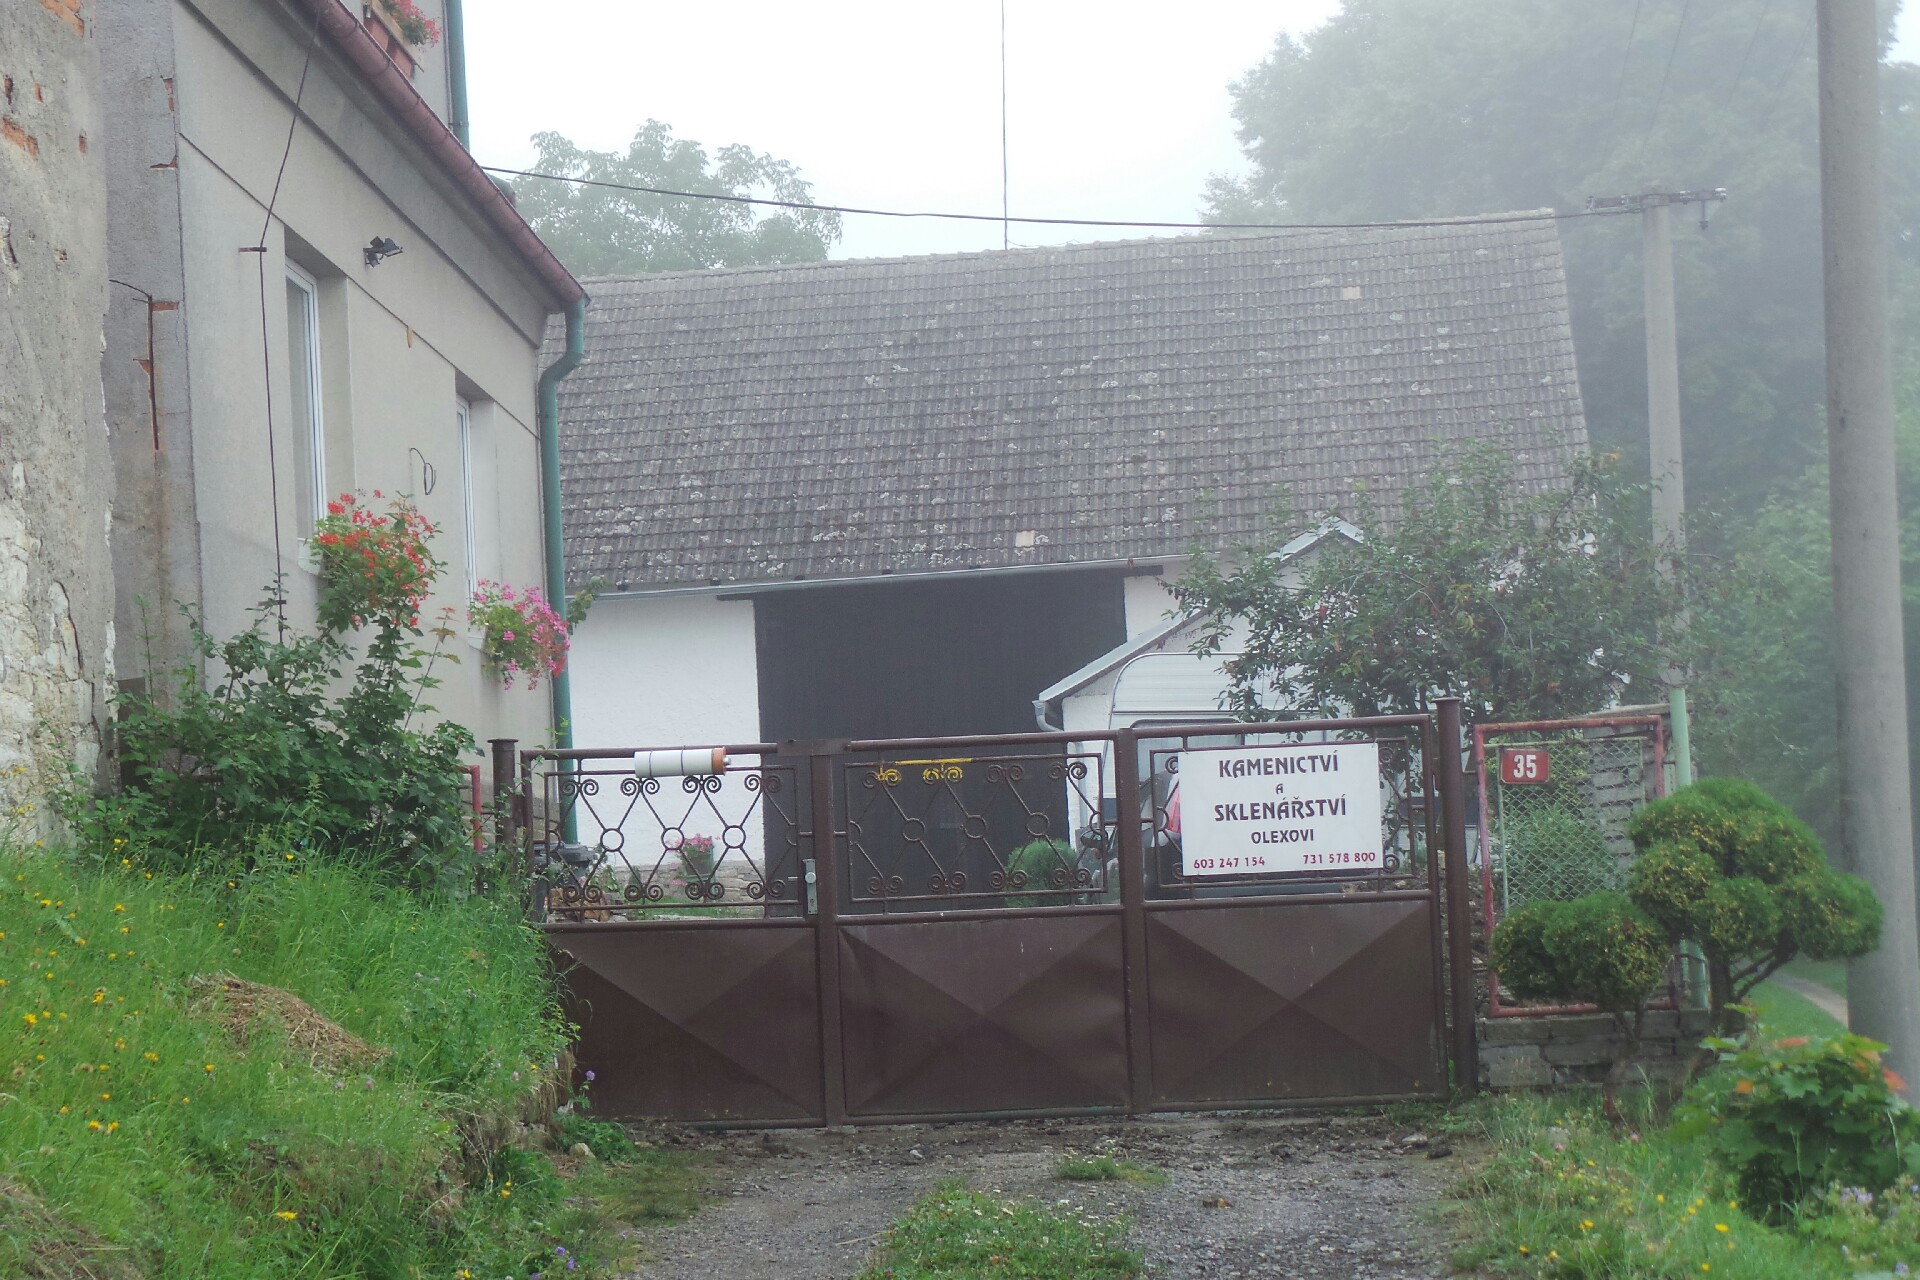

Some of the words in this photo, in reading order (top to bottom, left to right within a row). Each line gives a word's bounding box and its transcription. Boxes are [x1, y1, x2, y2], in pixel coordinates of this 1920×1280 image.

[1219, 749, 1339, 779] KAMENICTVÍ
[1513, 754, 1537, 779] 35
[1275, 783, 1284, 795] A
[1214, 793, 1346, 822] SKLENÁŘSTVÍ
[1250, 828, 1314, 845] OLEXOVI
[1193, 858, 1215, 869] 603
[1219, 857, 1239, 868] 247
[1244, 856, 1265, 867] 154
[1302, 853, 1323, 865] 731
[1329, 852, 1349, 864] 578
[1354, 851, 1376, 863] 800
